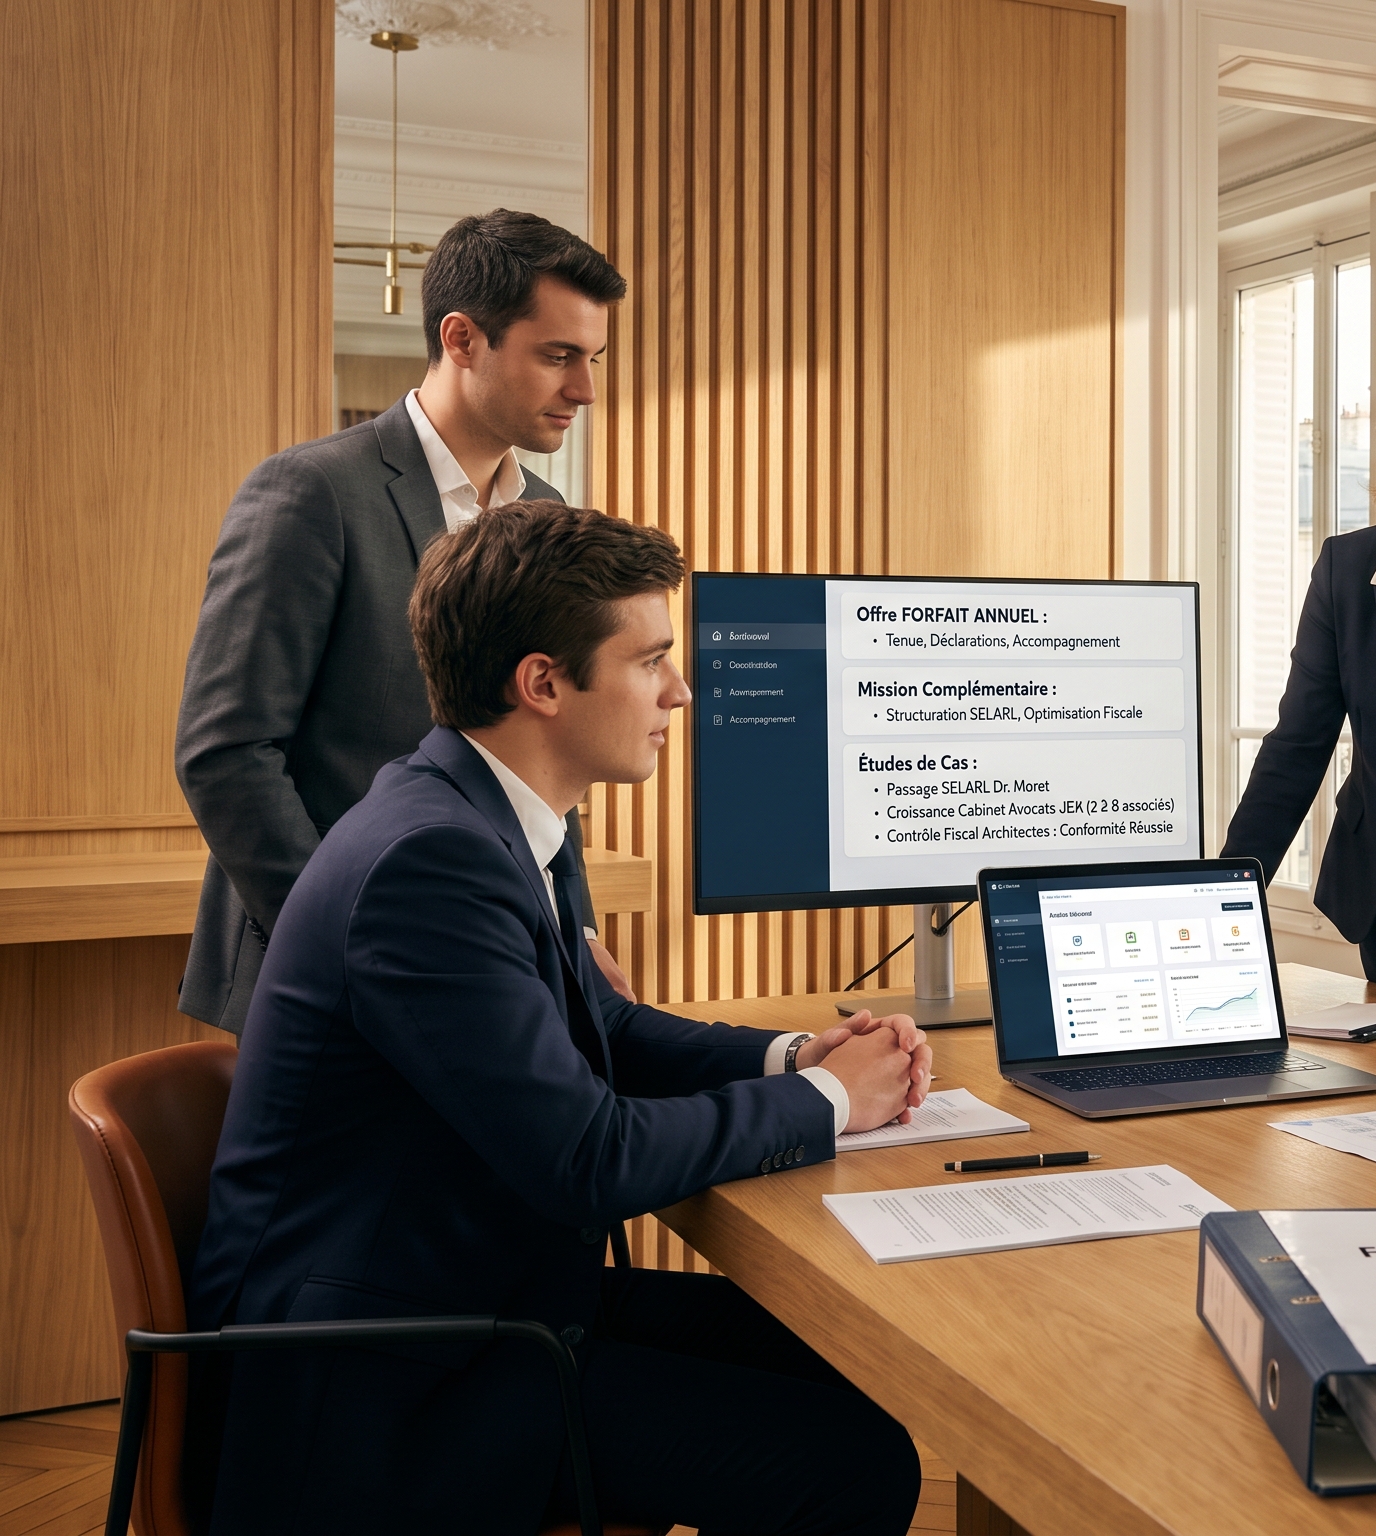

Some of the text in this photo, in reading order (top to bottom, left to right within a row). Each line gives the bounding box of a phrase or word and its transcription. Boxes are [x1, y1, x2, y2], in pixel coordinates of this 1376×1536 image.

[857, 605, 898, 622] Offre
[902, 607, 969, 623] FORFAIT
[974, 608, 1039, 624] ANNUEL
[886, 633, 1121, 652] Tenue, Déclarations, Accompagnement
[858, 681, 918, 697] Mission
[922, 680, 1049, 701] Complémentaire
[729, 715, 796, 726] Accompagnement
[886, 705, 1143, 724] Structuration SELARL, Optimisation Fiscale
[859, 752, 913, 772] Études
[917, 755, 937, 771] de
[941, 755, 969, 770] Cas
[887, 780, 1050, 799] Passage SELARL Dr. Moret
[887, 805, 955, 819] Croissance
[958, 804, 1006, 817] Cabinet
[1009, 803, 1056, 816] Avocats
[1059, 801, 1084, 814] JEK
[1087, 800, 1098, 817] (2
[1111, 799, 1120, 813] 8
[1123, 798, 1175, 814] associés)
[887, 827, 941, 843] Contrôle
[944, 827, 979, 841] Fiscal
[982, 825, 1051, 840] Architectes
[1060, 821, 1127, 837] Conformité
[1130, 821, 1174, 834] Réussie
